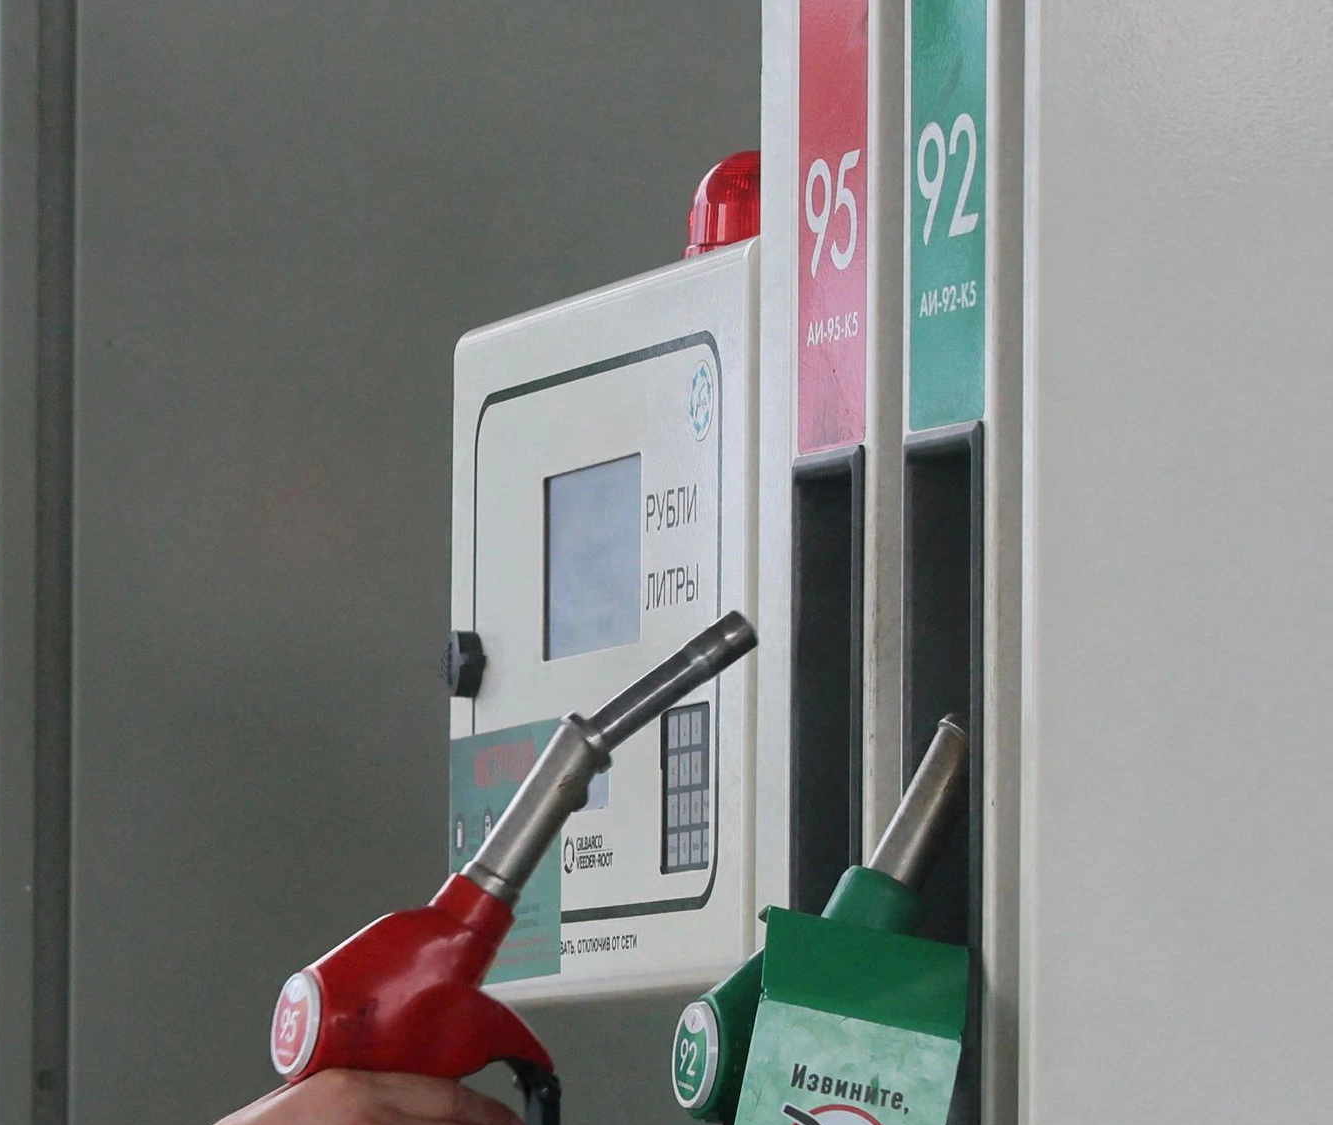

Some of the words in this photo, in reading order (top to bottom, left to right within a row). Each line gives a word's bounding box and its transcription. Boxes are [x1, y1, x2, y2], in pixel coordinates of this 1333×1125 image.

[917, 113, 979, 246] 92
[805, 149, 861, 278] 95
[919, 281, 977, 318] АИ-92-К5
[807, 312, 859, 347] АИ-95-К5
[646, 483, 697, 533] РУБЛИ
[645, 563, 699, 611] ЛИТРЫ
[576, 835, 603, 851] GILBARCO
[612, 936, 620, 951] ОТ
[621, 934, 637, 950] СЕТИ
[280, 1008, 301, 1043] 95
[679, 1038, 698, 1077] 92
[790, 1063, 909, 1115] Извините,
